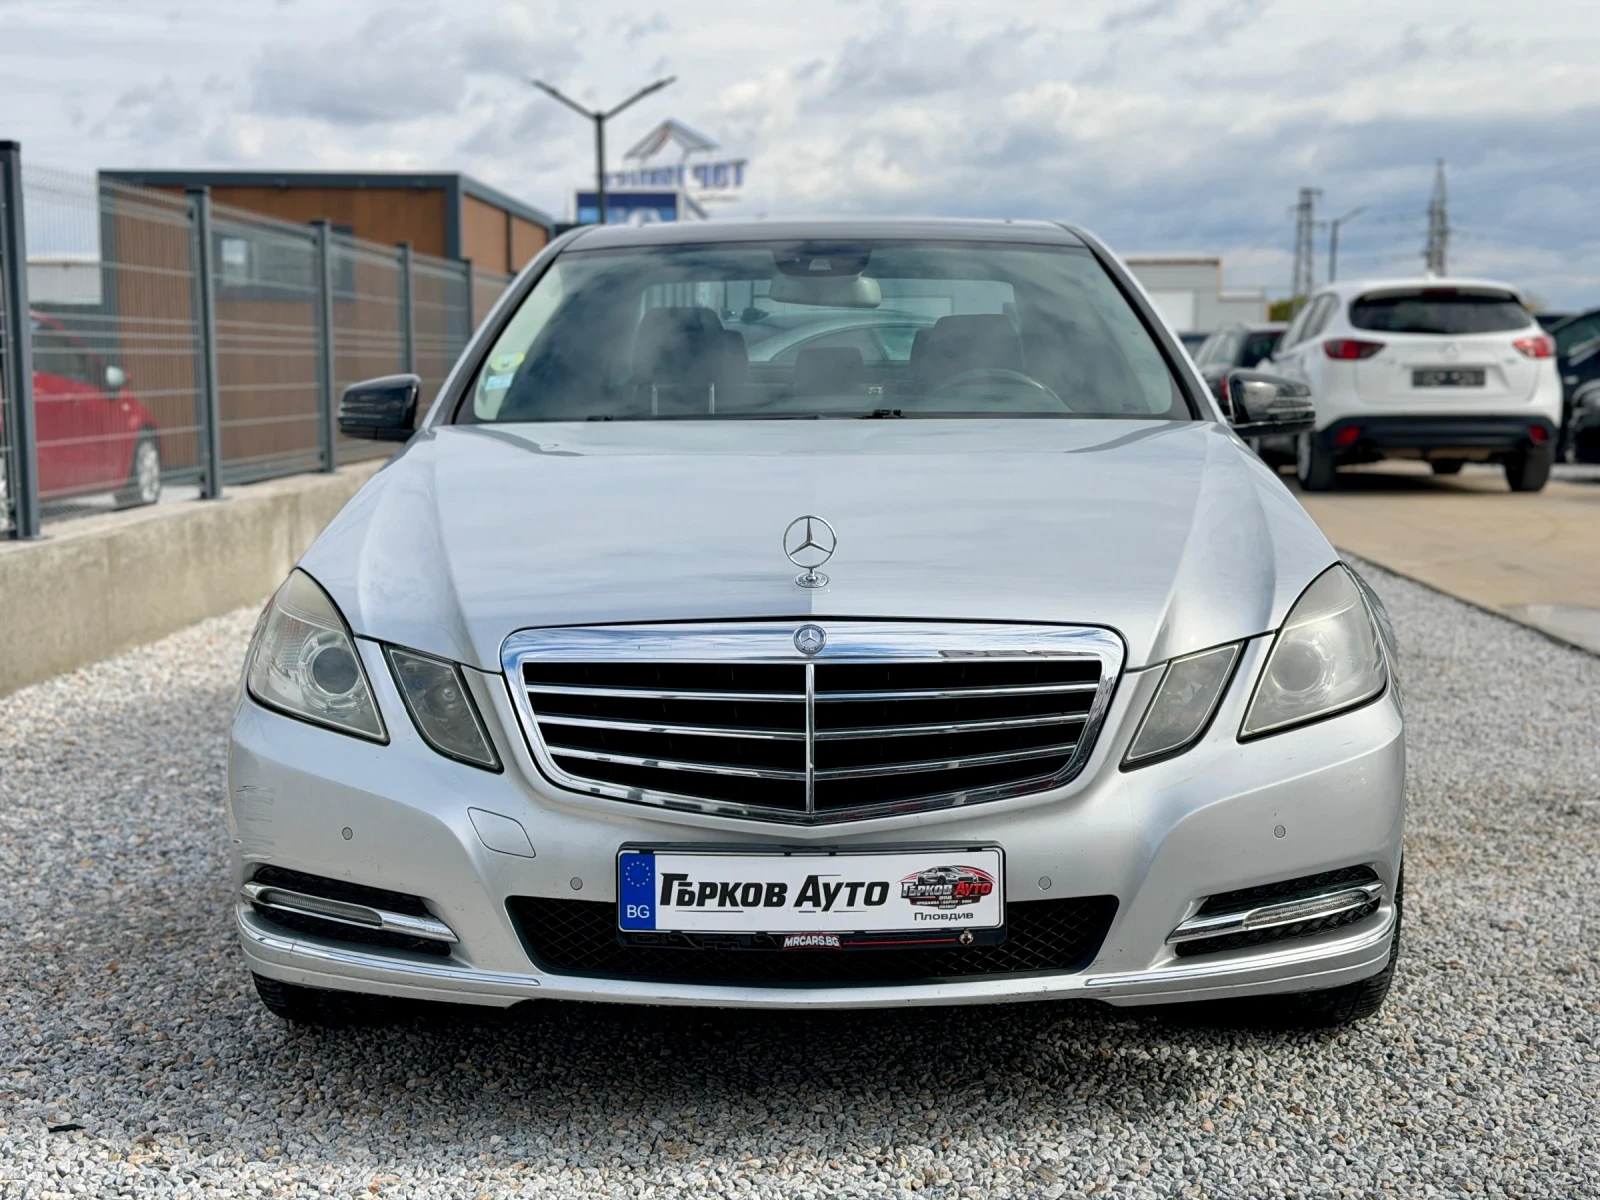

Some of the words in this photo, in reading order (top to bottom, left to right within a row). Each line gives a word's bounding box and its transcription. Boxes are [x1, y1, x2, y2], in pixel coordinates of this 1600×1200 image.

[626, 904, 650, 919] BG
[914, 911, 974, 921] Пловдив
[783, 935, 840, 948] MRCARS.BG
